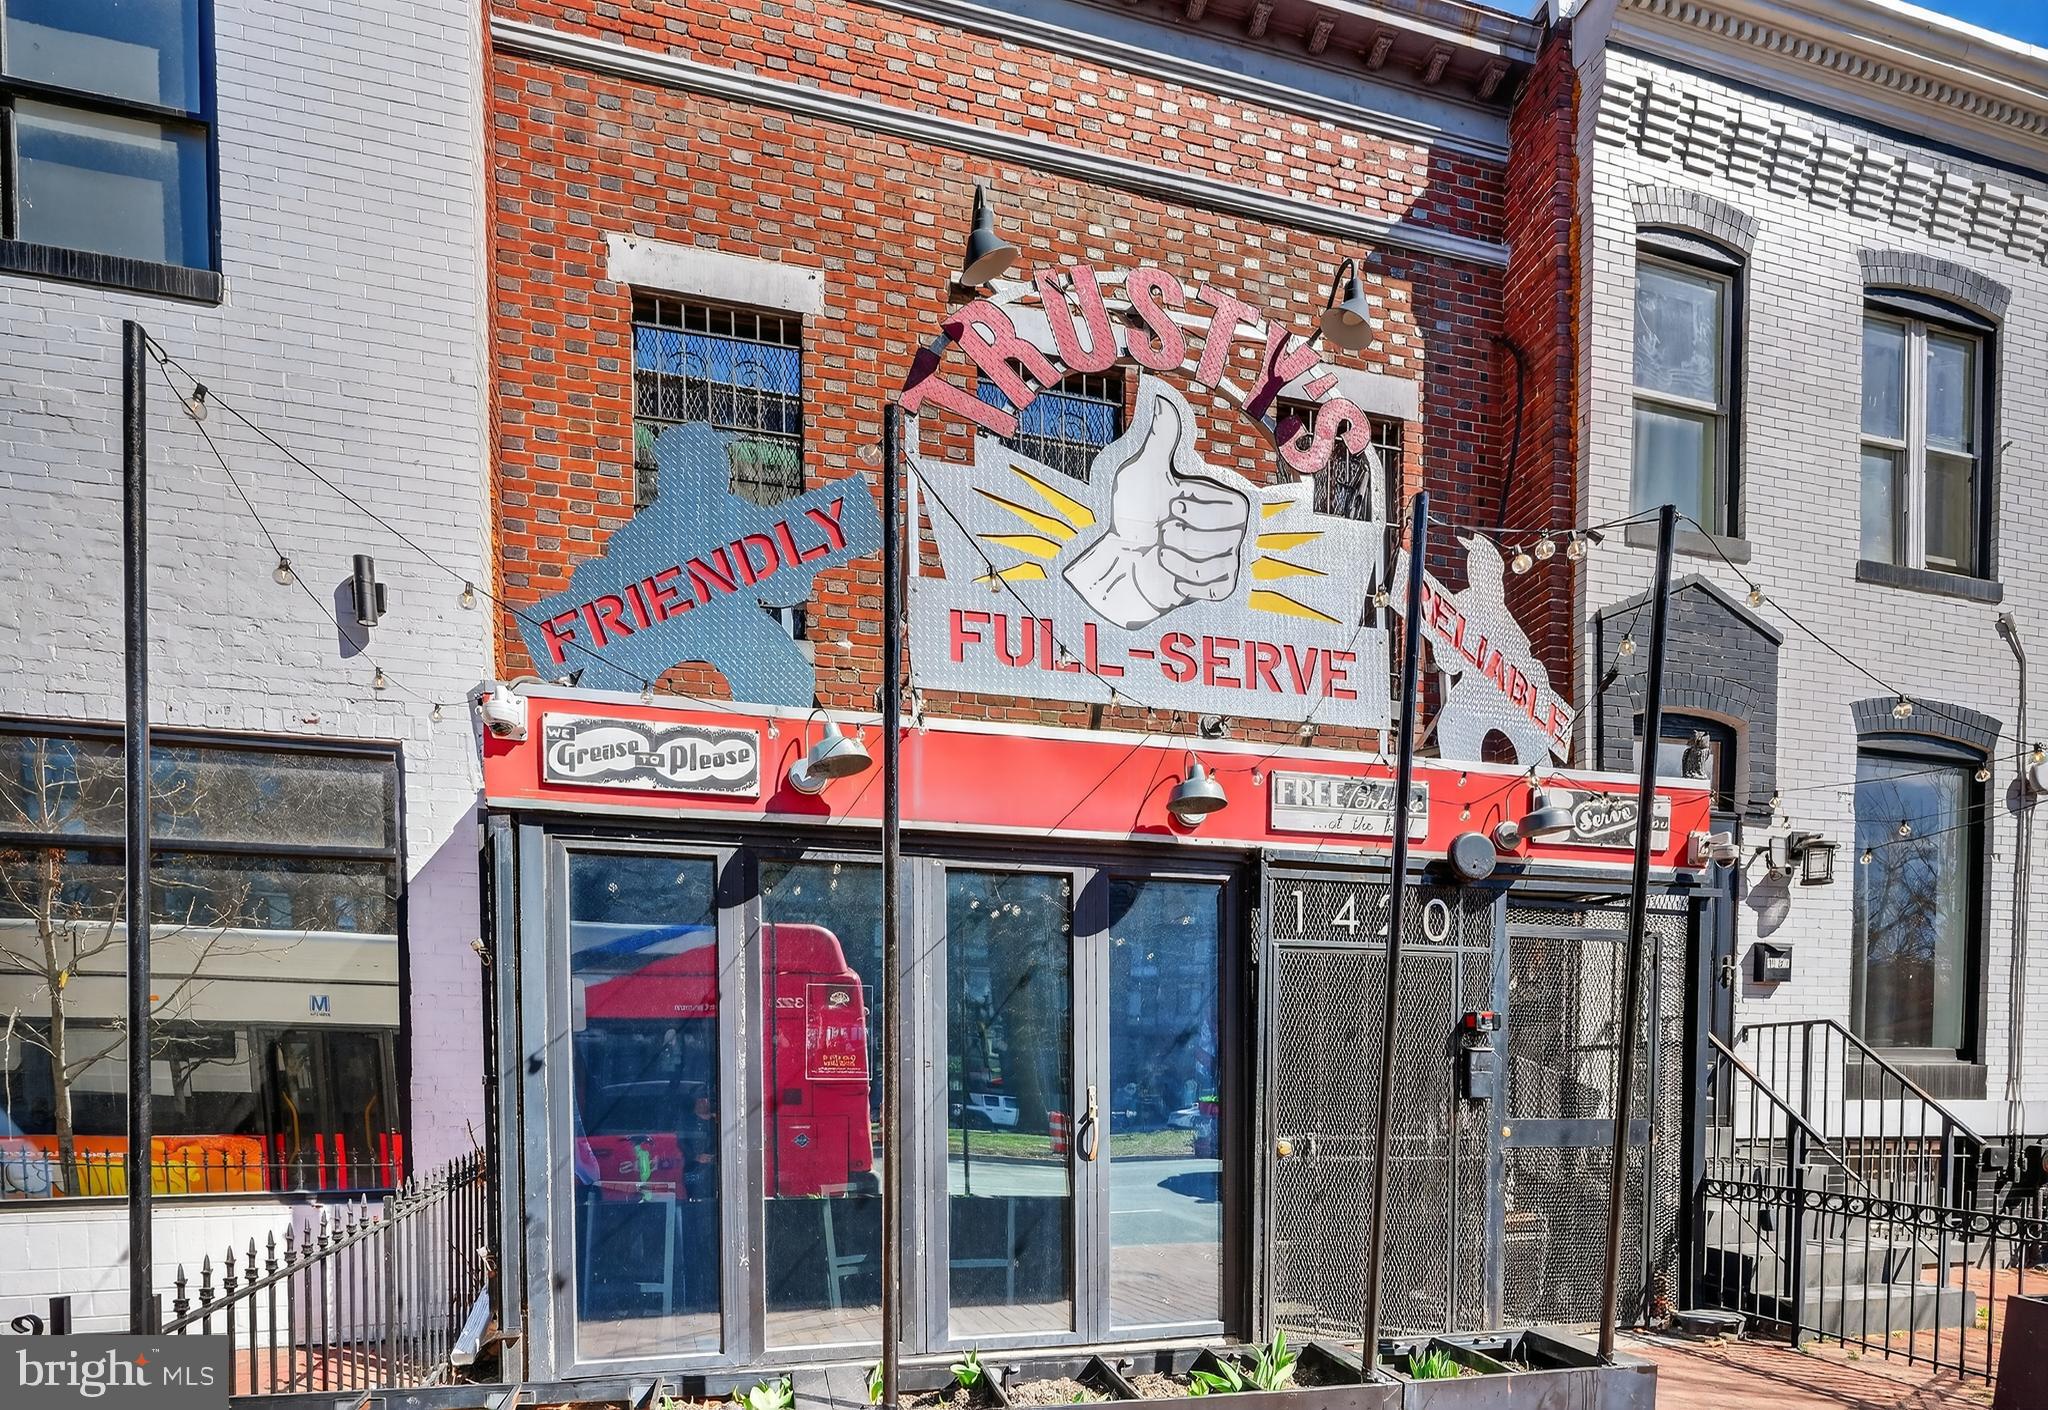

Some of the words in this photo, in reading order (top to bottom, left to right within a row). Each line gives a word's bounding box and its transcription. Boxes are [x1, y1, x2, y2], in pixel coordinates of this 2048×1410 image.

[899, 265, 1371, 474] TRUSTY'S
[541, 496, 847, 665] FRIENDLY
[950, 608, 1357, 700] FULL-SERVE
[557, 740, 640, 773] Grease
[669, 743, 750, 775] Please
[1277, 778, 1345, 808] FREE
[1347, 784, 1424, 812] Park
[1579, 805, 1634, 831] Serve
